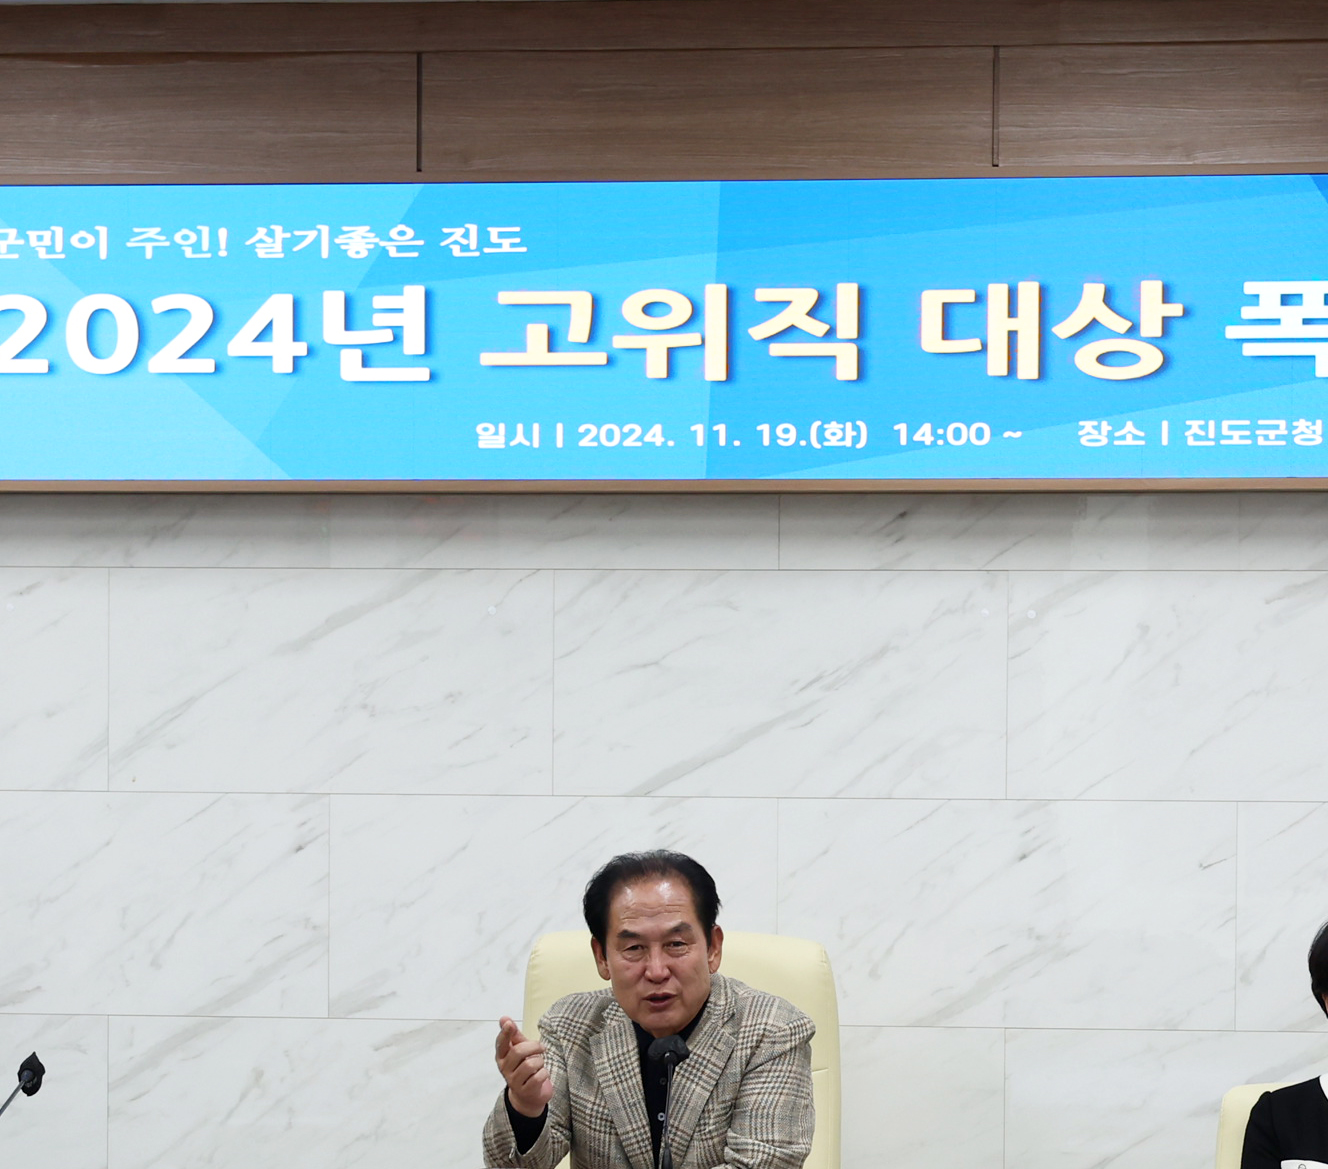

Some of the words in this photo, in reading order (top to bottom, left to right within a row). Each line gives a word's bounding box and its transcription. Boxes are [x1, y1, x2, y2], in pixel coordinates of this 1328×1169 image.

[125, 225, 229, 259] 주인!
[245, 224, 425, 259] 살기좋은
[440, 223, 529, 257] 진도
[478, 281, 859, 383] 고위직
[919, 279, 1185, 381] 대상
[475, 422, 540, 449] 일시
[578, 423, 675, 447] 2024.
[690, 423, 741, 447] 11.
[756, 420, 868, 449] 19.(화)
[893, 422, 991, 446] 14:00
[1078, 420, 1146, 447] 장소
[1184, 418, 1323, 446] 진도군청
